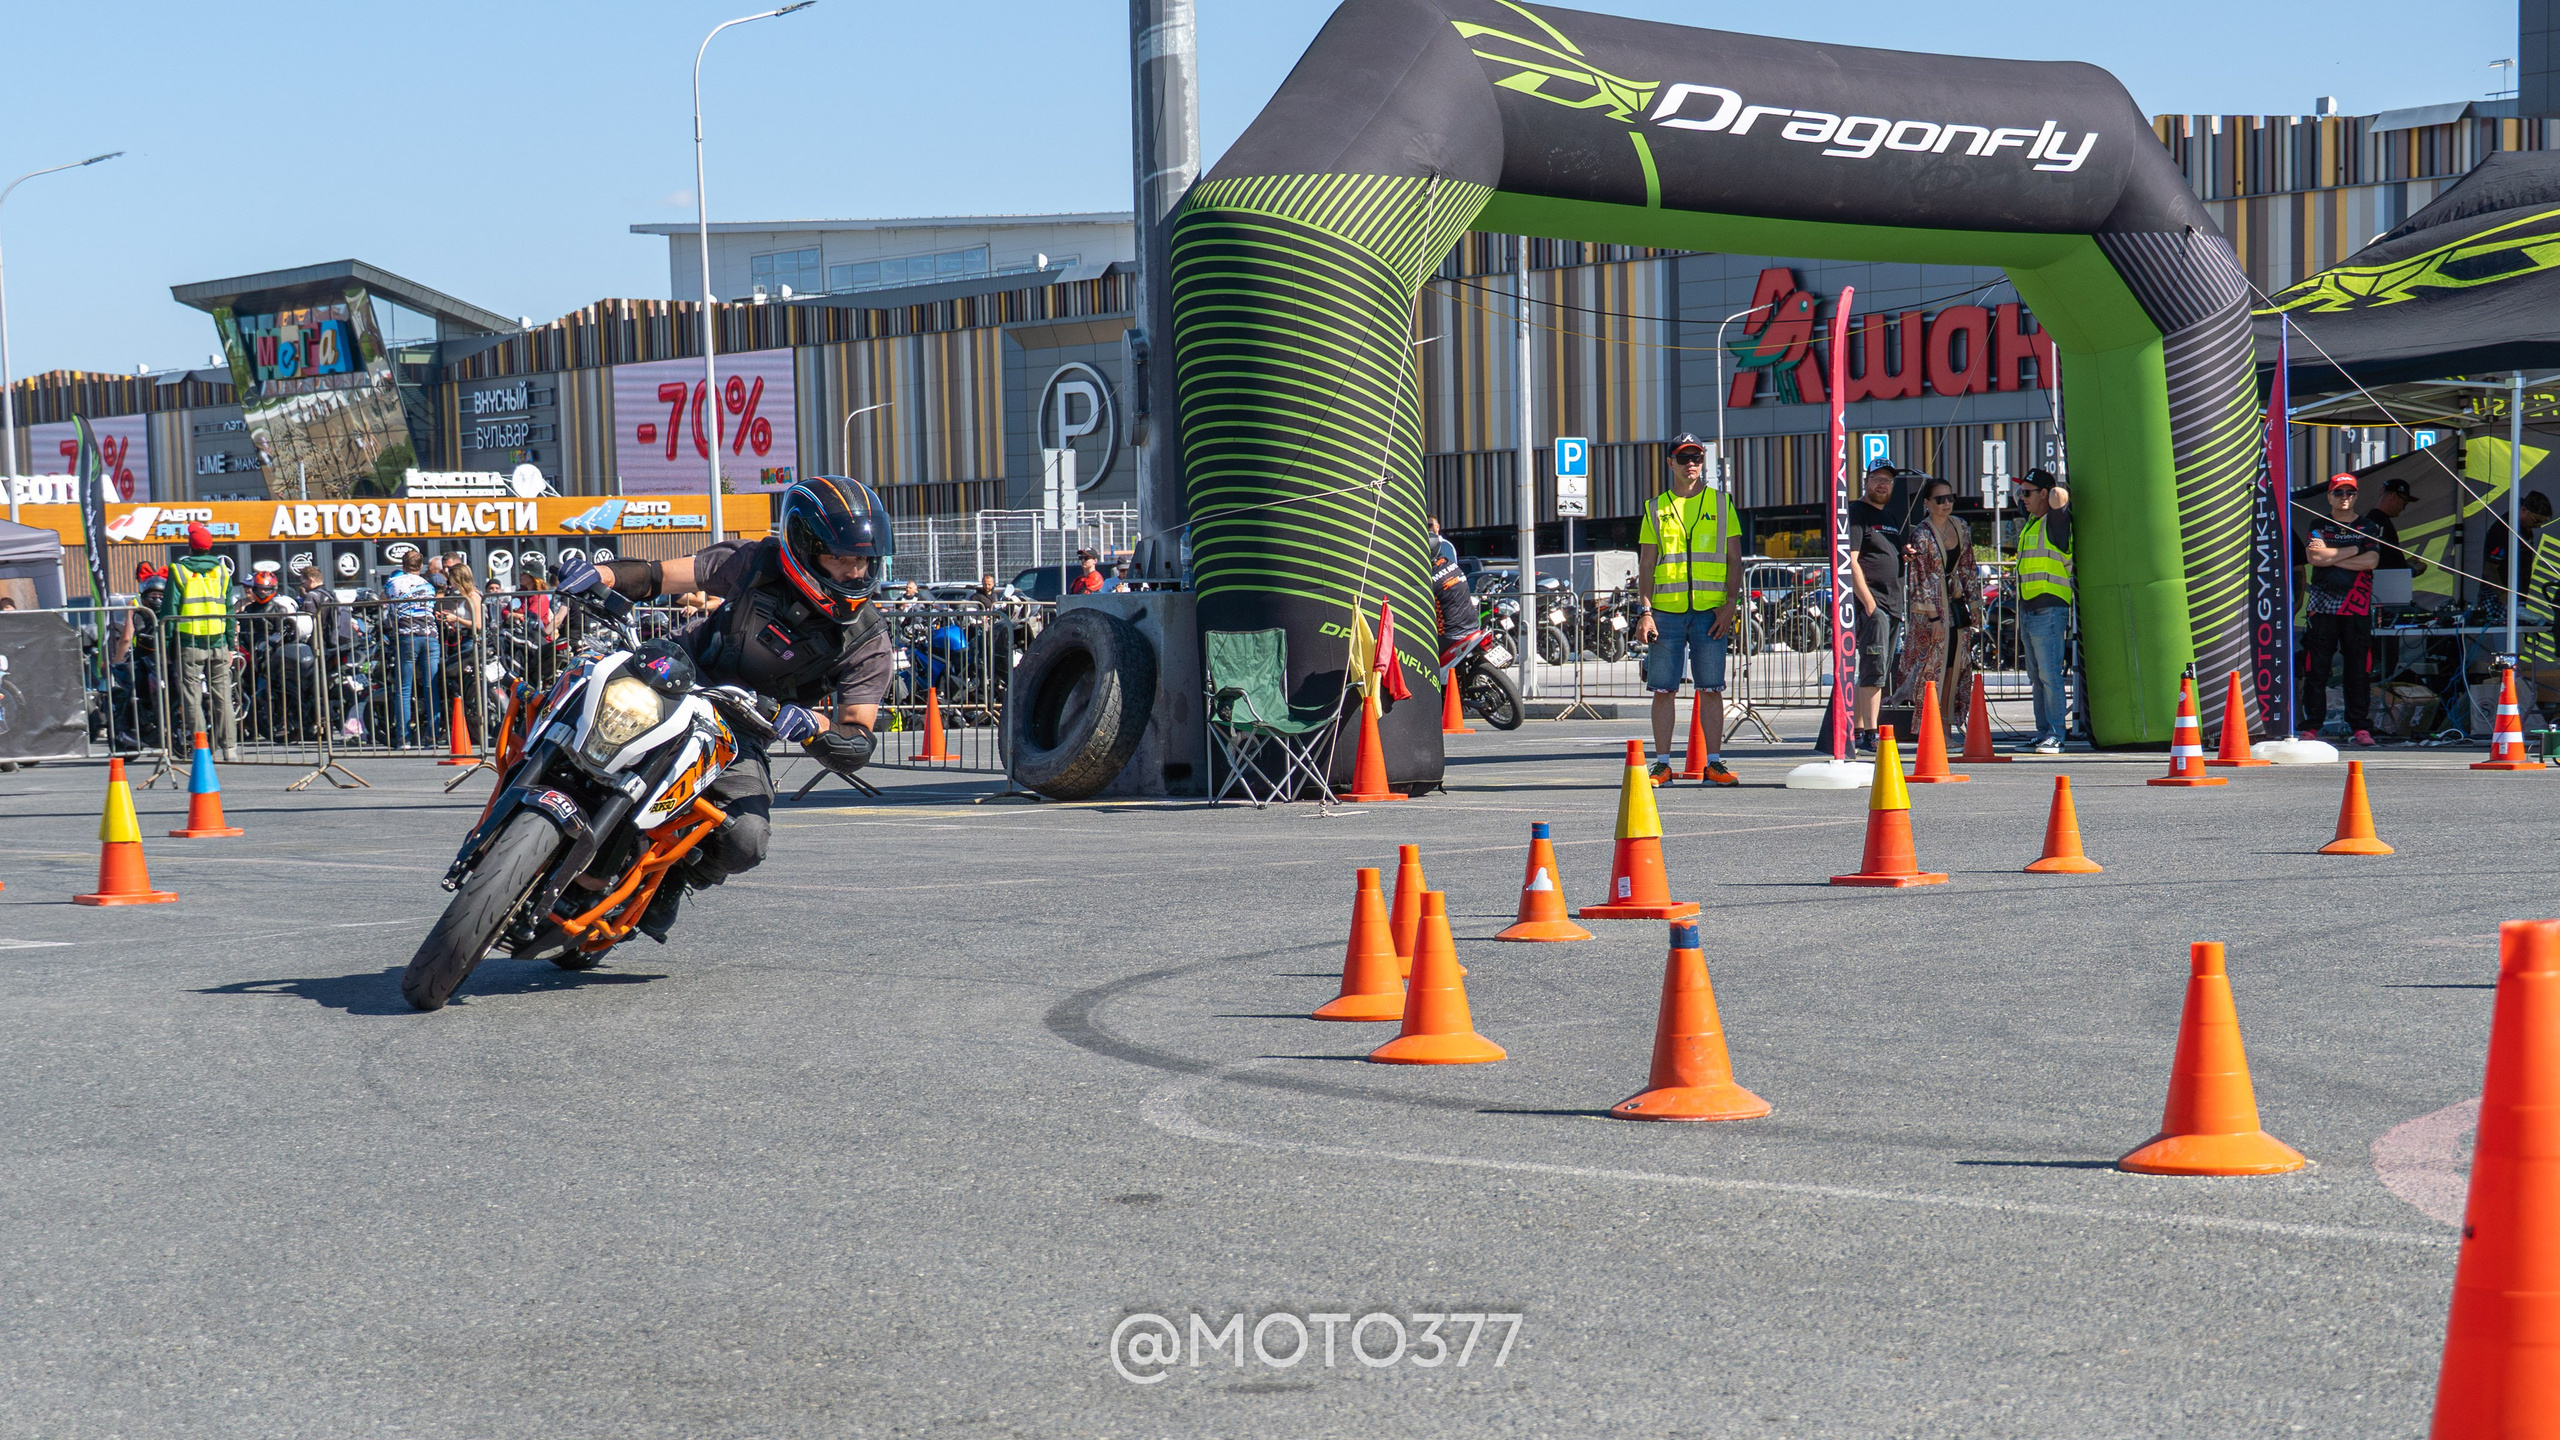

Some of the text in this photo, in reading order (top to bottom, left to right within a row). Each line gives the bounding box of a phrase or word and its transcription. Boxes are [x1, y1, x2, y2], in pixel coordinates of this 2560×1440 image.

[1650, 83, 2098, 172] Dragonfly
[474, 381, 528, 414] ВКУСНЫЙ
[637, 375, 772, 462] -70%
[1057, 381, 1099, 449] P
[476, 423, 529, 449] БУЛЬВАР
[1869, 438, 1885, 460] P
[198, 454, 226, 475] LIME
[1564, 442, 1582, 472] P
[2044, 461, 2056, 474] 10
[159, 508, 213, 521] АВТО
[270, 501, 538, 537] АВТОЗАПЧАСТИ
[624, 501, 671, 513] АВТО
[156, 523, 240, 537] ЯПНЕЦ
[622, 515, 707, 528] ЕВРОПЕЕЦ
[2270, 510, 2283, 721] EKATERINBURG
